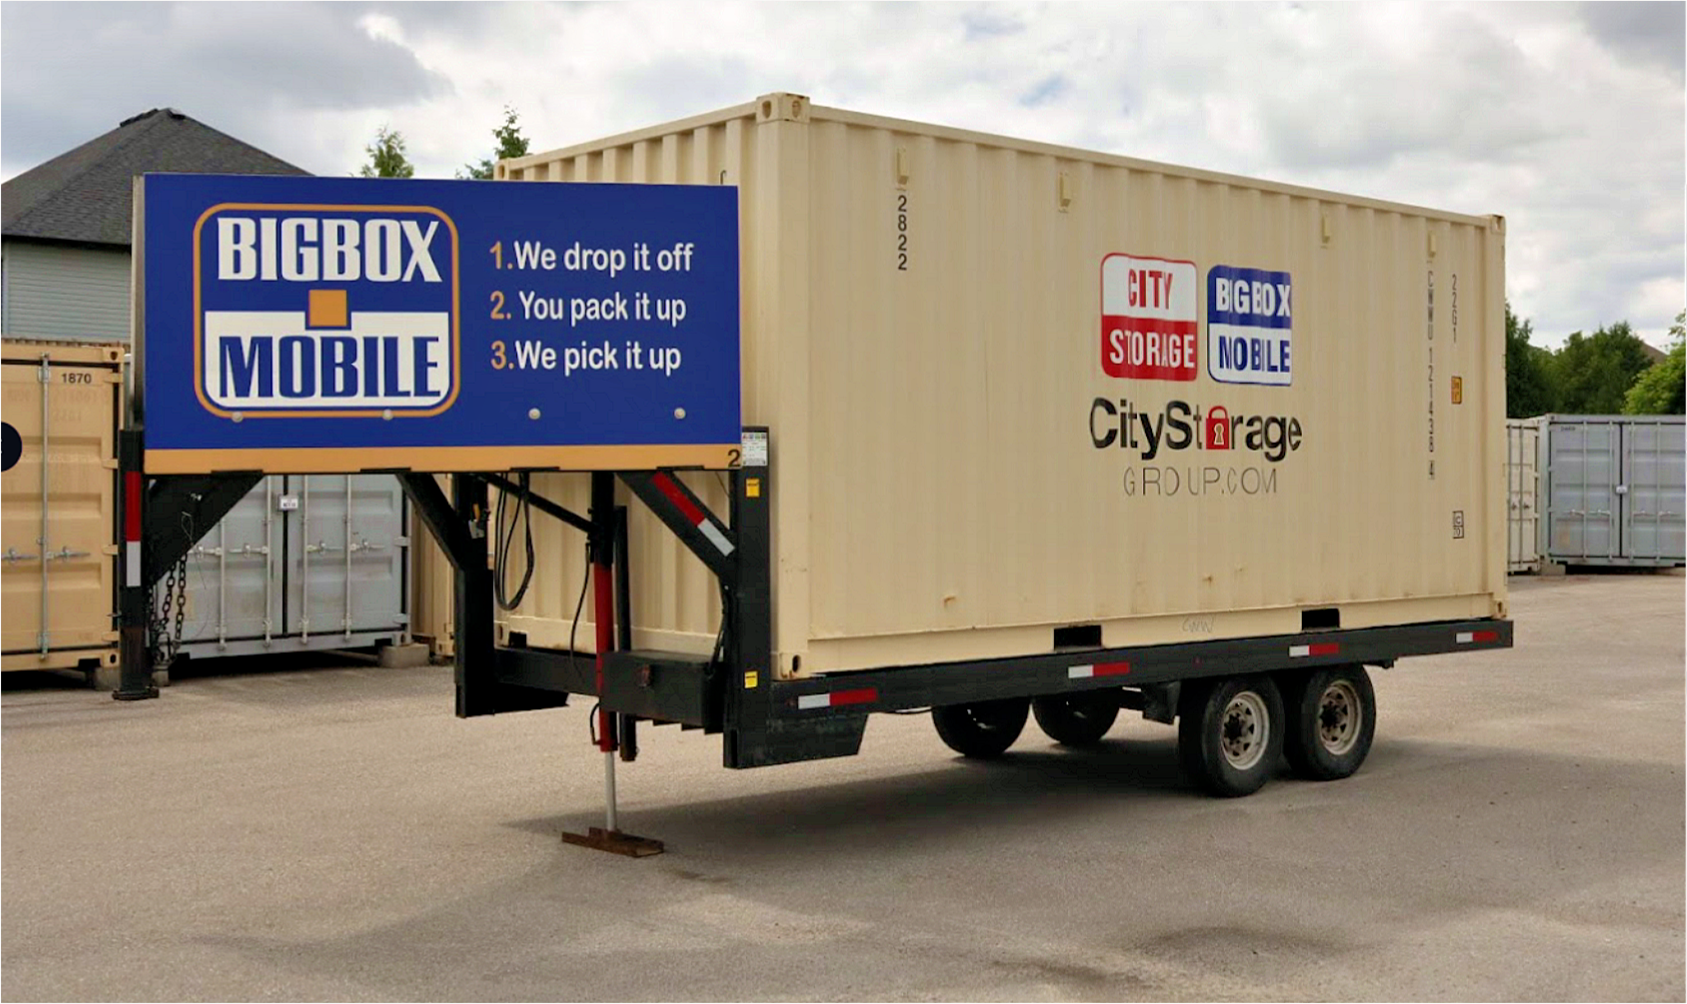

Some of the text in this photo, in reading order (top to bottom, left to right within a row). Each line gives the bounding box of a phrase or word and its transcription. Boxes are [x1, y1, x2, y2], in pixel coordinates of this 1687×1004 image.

[217, 217, 443, 282] BIGBOX
[897, 195, 908, 271] 2822
[563, 241, 626, 279] drop
[633, 242, 651, 272] it
[656, 242, 695, 272] off
[489, 290, 688, 327] 2. You pack it up
[1128, 268, 1174, 310] CITY
[219, 335, 442, 399] MOBILE
[564, 340, 619, 377] pick
[626, 341, 643, 370] it
[649, 347, 682, 377] up
[1109, 328, 1195, 369] STORAGE
[61, 372, 92, 384] 1870
[727, 449, 741, 468] 2
